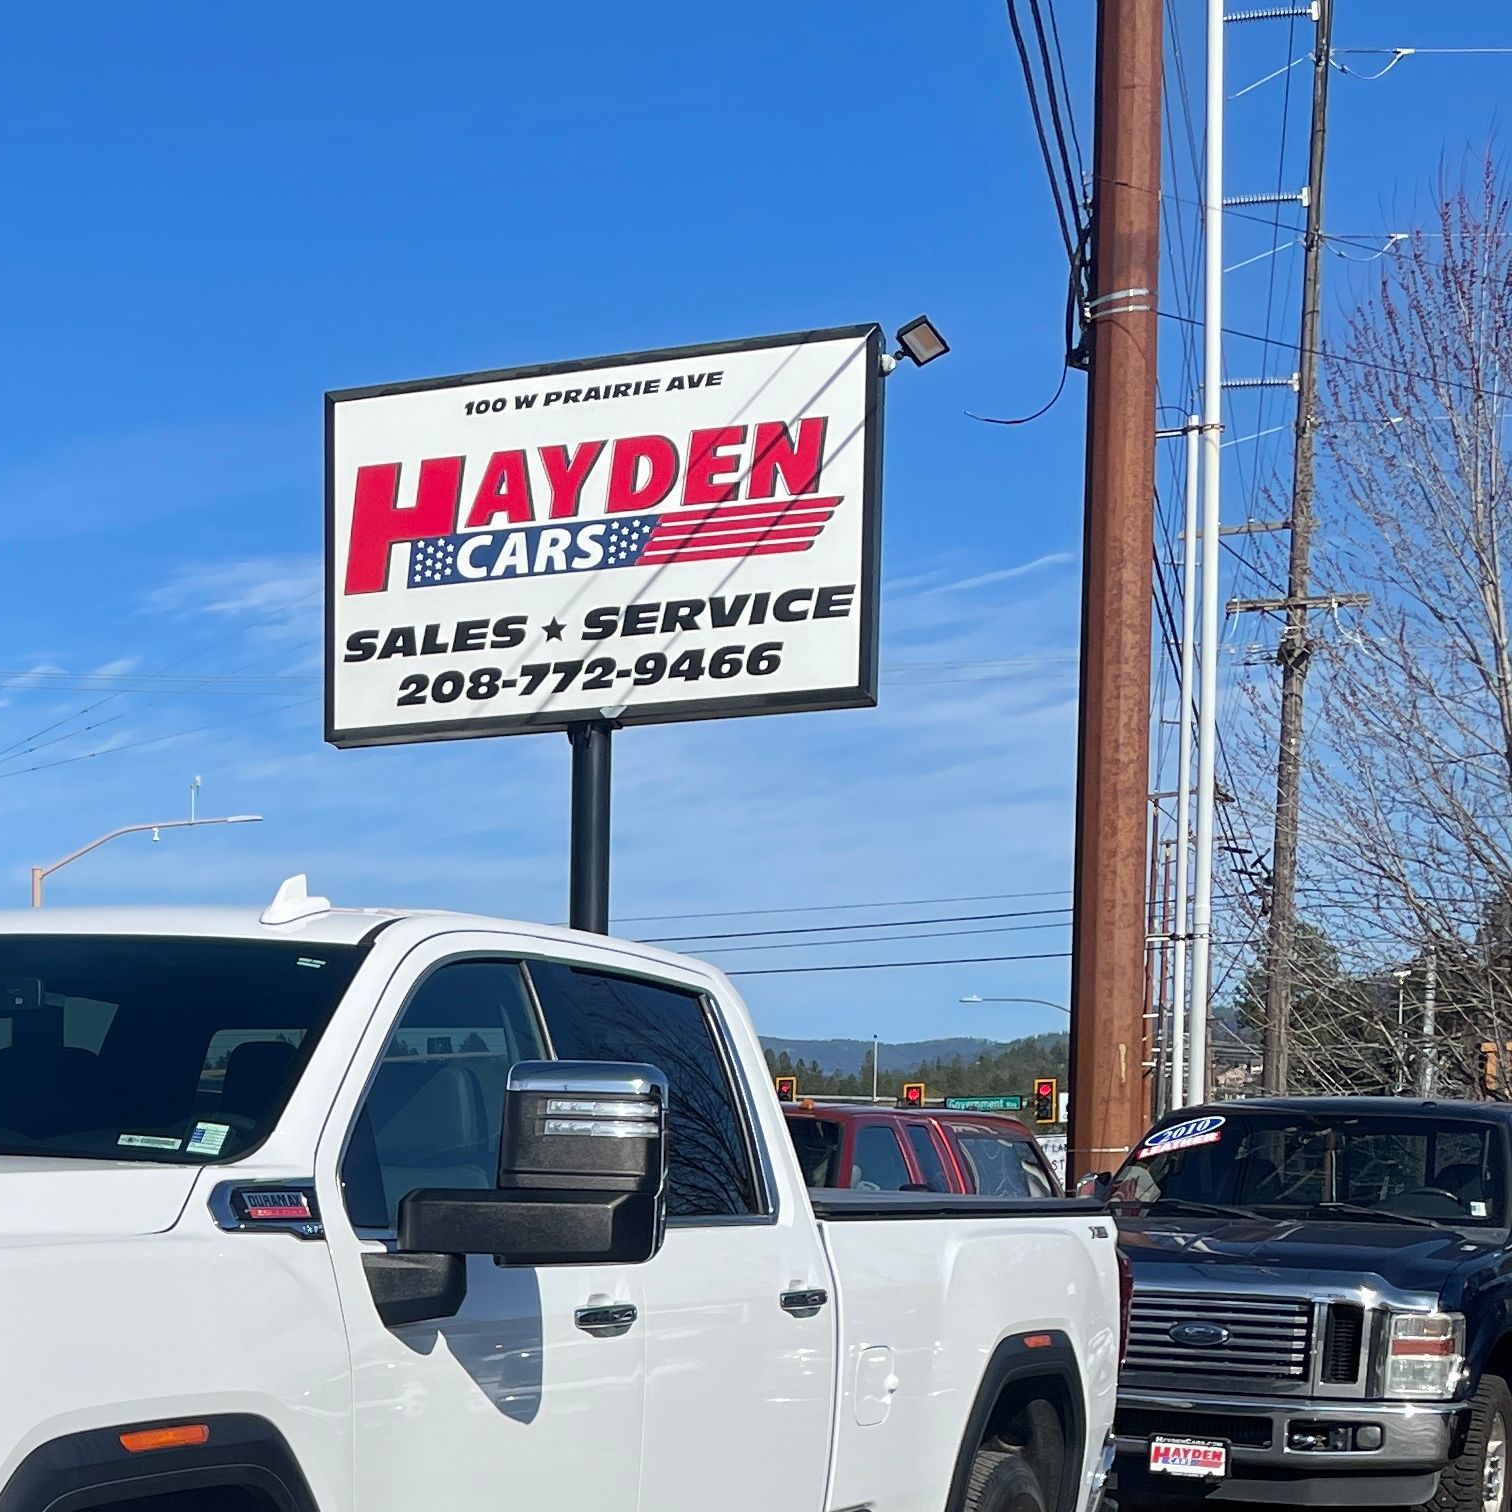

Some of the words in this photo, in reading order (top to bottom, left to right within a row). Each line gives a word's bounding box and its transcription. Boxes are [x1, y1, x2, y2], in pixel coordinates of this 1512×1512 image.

[464, 398, 508, 416] 100
[514, 393, 539, 410] W
[543, 379, 661, 407] PRAIRIE
[665, 371, 725, 392] AVE
[345, 416, 829, 595] HAYDEN
[455, 521, 607, 580] CARS
[344, 615, 529, 663] SALES
[581, 584, 857, 641] SERVICE
[395, 641, 785, 707] 208-772-9466
[1162, 1119, 1211, 1142] 2010
[247, 1194, 303, 1208] DURAMAX
[1151, 1446, 1223, 1463] HAYDEN
